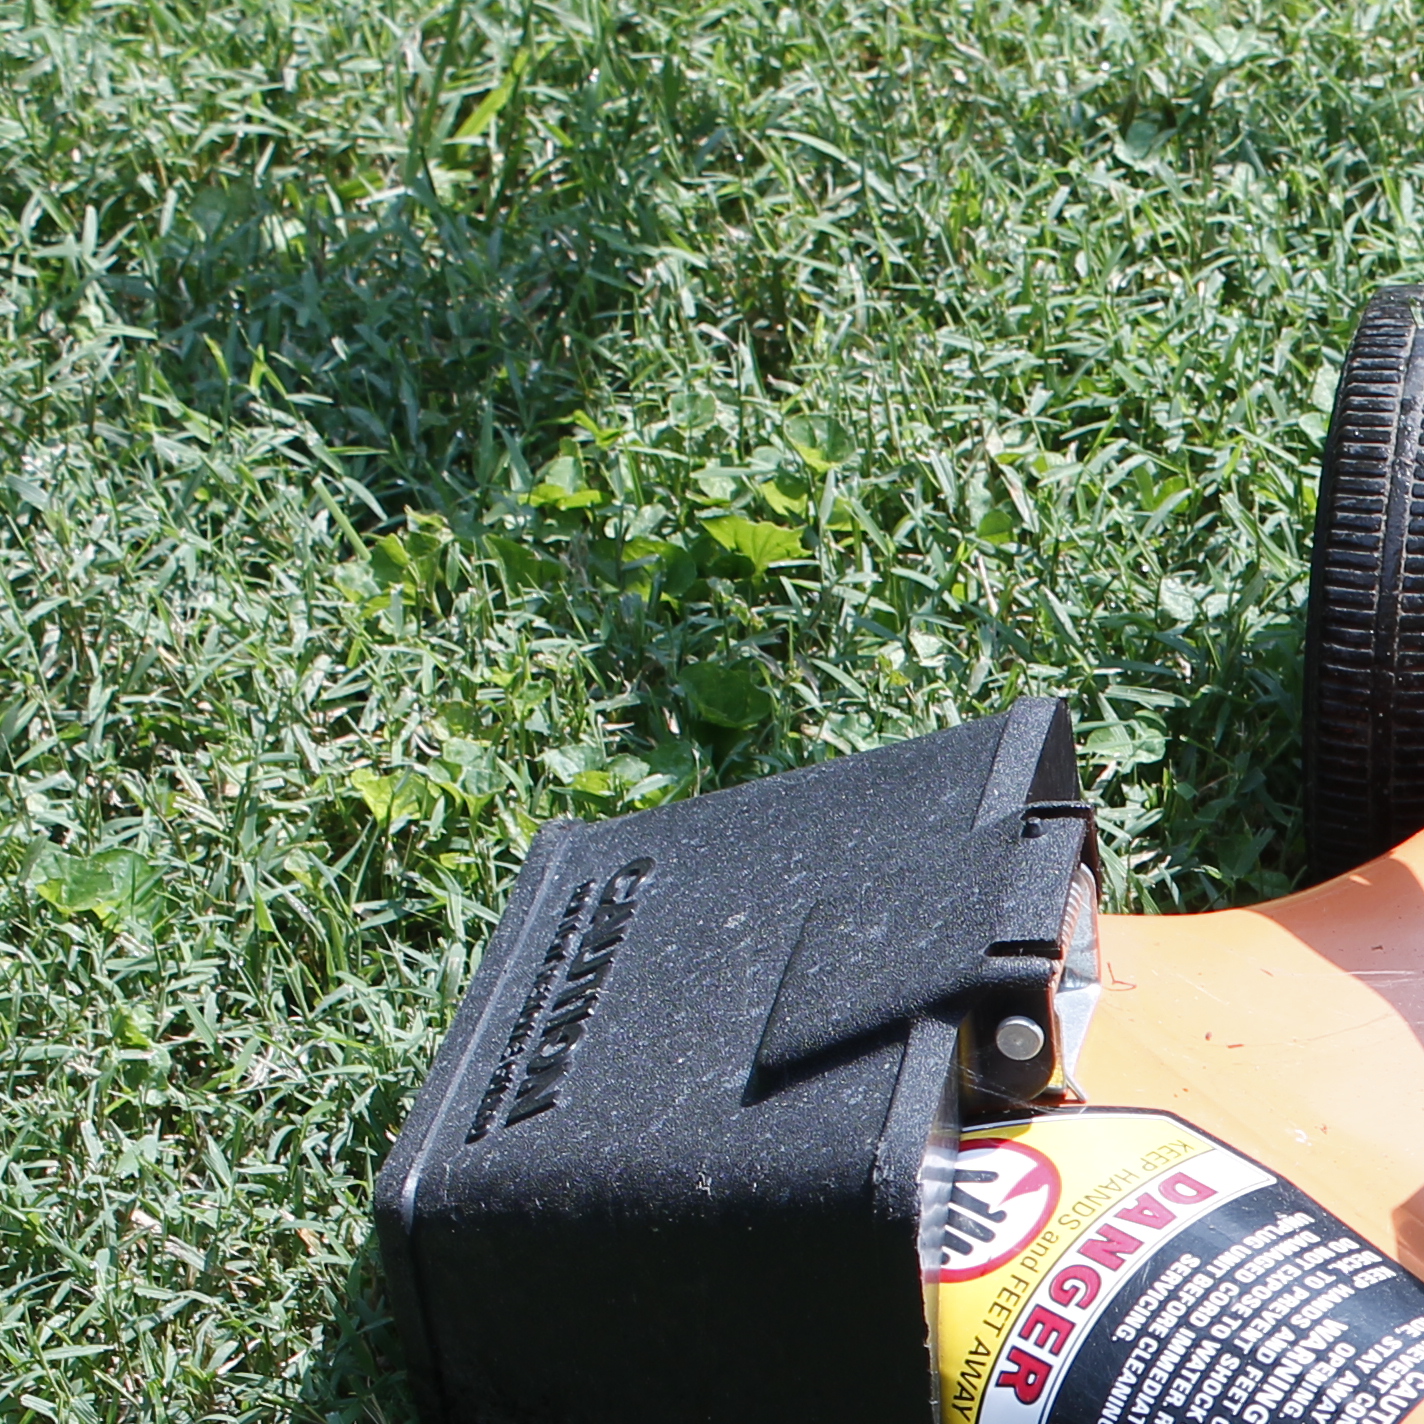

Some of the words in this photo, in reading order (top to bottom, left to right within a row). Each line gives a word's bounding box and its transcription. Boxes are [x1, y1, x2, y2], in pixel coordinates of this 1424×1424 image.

[504, 856, 656, 1129] CAUTION
[1142, 1139, 1195, 1171] KEEP
[1058, 1169, 1140, 1230] HANDS
[1020, 1231, 1059, 1273] and
[1242, 1212, 1316, 1249] UNPLUG
[1328, 1237, 1360, 1253] DO
[1207, 1247, 1253, 1278] UNIT
[1234, 1230, 1321, 1283] DAMAGED
[1295, 1247, 1330, 1270] NOT
[1304, 1270, 1336, 1289] TO
[1327, 1250, 1383, 1274] DECK.
[1352, 1265, 1397, 1289] KEEP
[983, 1273, 1029, 1338] FEET
[996, 1172, 1218, 1405] DANGER
[1111, 1253, 1201, 1343] SERVICING.
[1147, 1273, 1214, 1346] BEFORE
[1190, 1282, 1239, 1328] CORD
[1231, 1264, 1301, 1318] EXPOSE
[1291, 1284, 1355, 1329] HANDS
[1210, 1317, 1243, 1340] TO
[1234, 1285, 1310, 1353] PREVENT
[1256, 1326, 1296, 1365] AND
[1355, 1336, 1404, 1374] STAY
[952, 1337, 991, 1423] AWAY
[1162, 1338, 1222, 1407] WATER.
[1187, 1353, 1240, 1423] SHOCK
[1220, 1365, 1263, 1415] FEET
[1278, 1342, 1356, 1419] OPENING.
